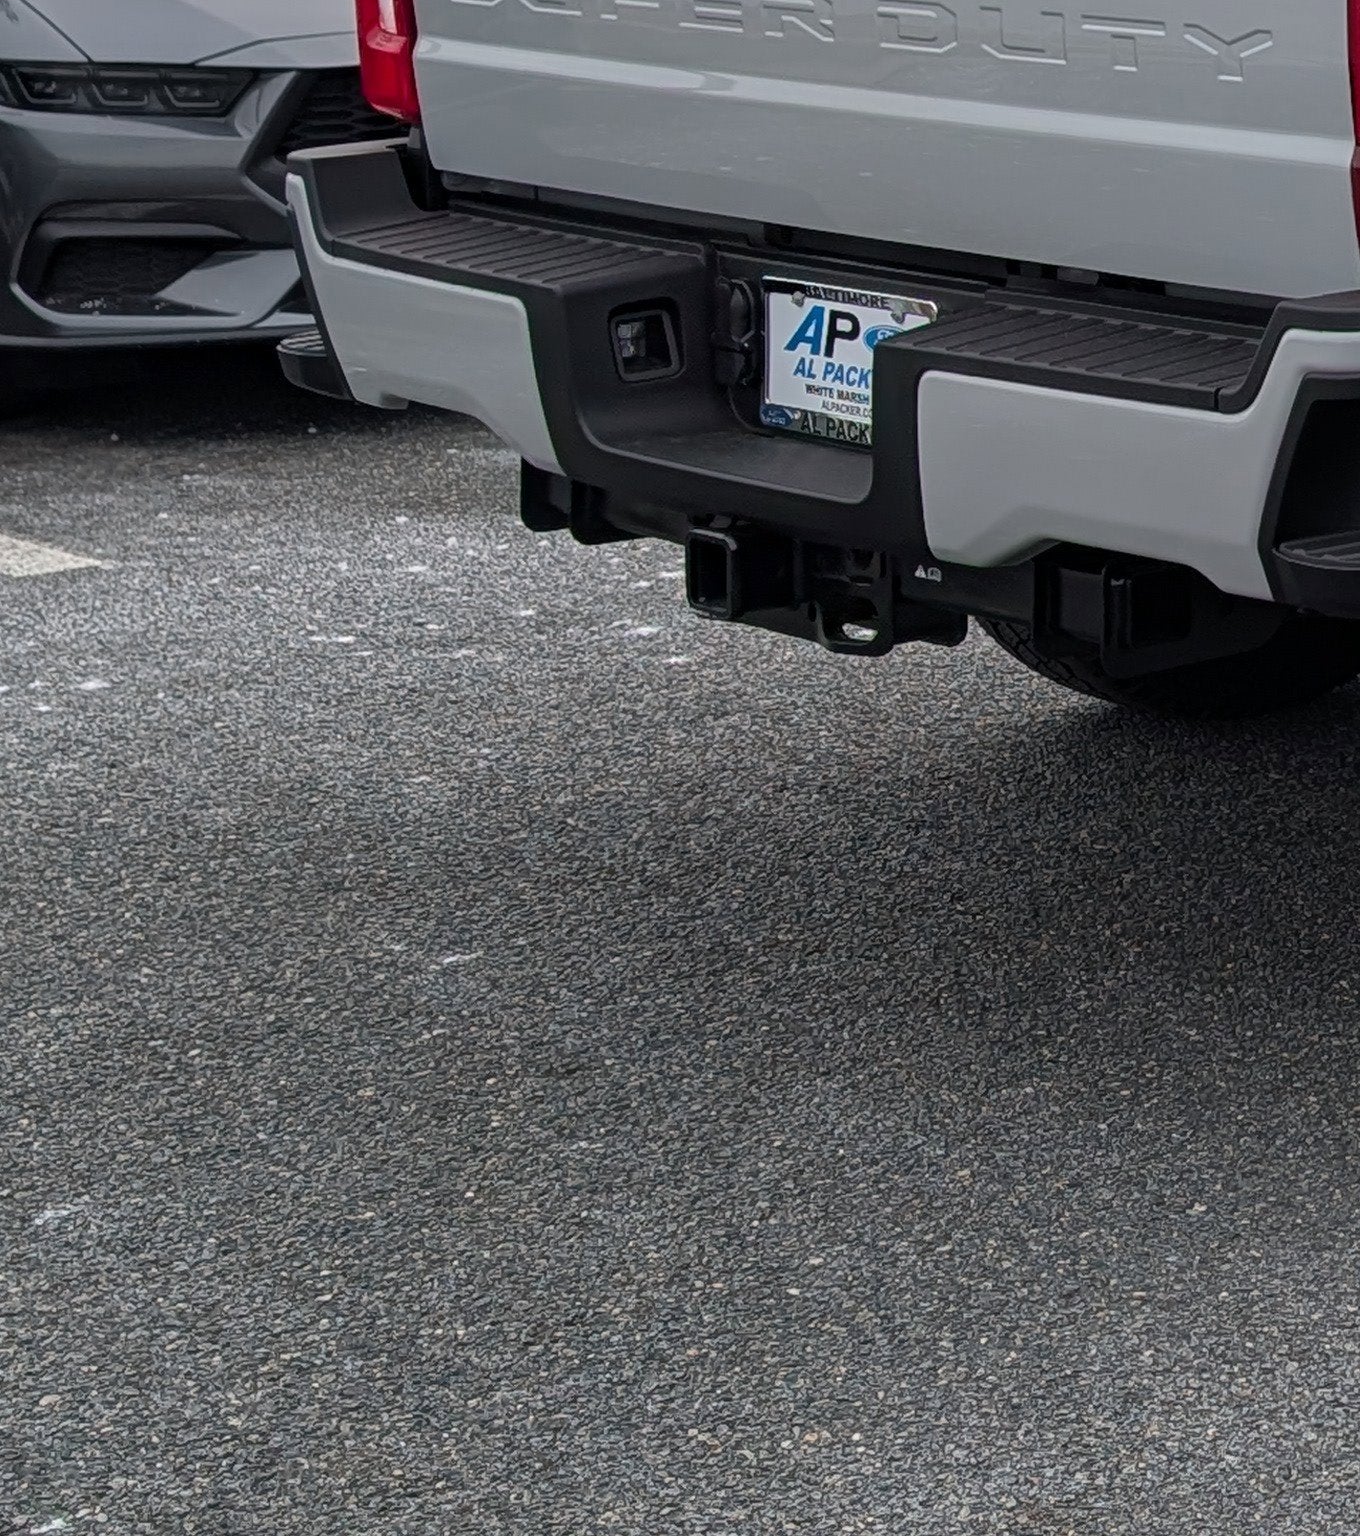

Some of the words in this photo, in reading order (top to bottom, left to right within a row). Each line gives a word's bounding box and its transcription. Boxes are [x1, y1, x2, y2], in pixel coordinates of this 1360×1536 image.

[784, 305, 861, 358] AP
[793, 357, 816, 379] AL
[801, 412, 821, 435] AL
